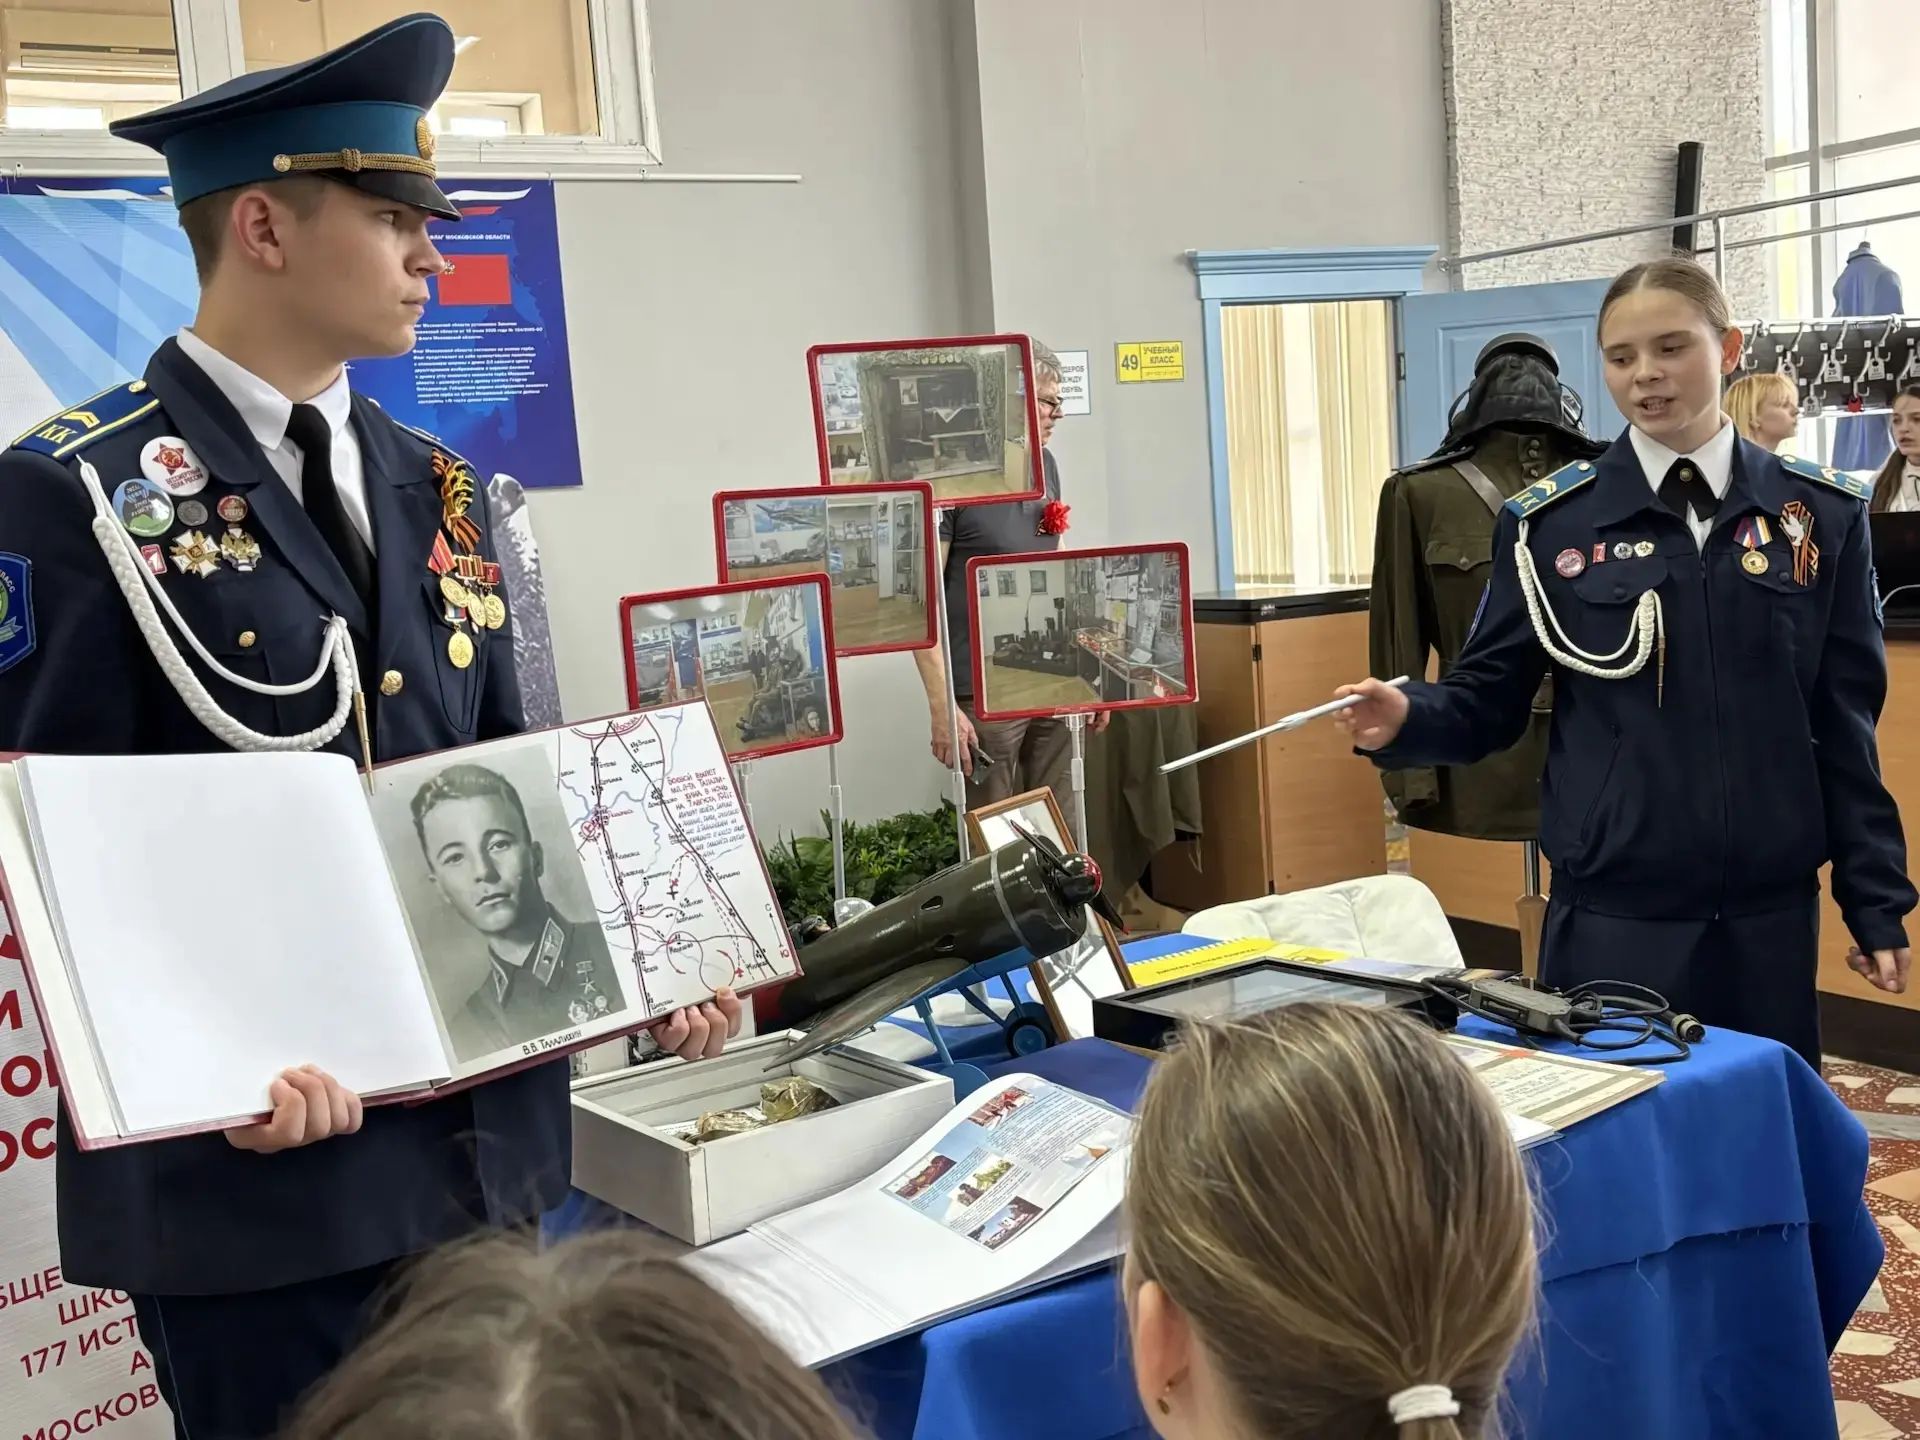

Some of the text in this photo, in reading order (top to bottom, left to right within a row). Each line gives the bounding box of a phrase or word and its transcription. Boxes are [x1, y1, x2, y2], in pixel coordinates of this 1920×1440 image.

[1143, 344, 1179, 354] УЧЕБНЫЙ
[1121, 354, 1138, 370] 49
[1149, 356, 1174, 364] КЛАСС
[695, 768, 717, 779] ВЫЛЕТ
[704, 787, 710, 795] В
[764, 903, 772, 912] С
[780, 949, 790, 958] Ю
[20, 1314, 137, 1378] 177 ИСТ
[130, 1350, 151, 1376] А
